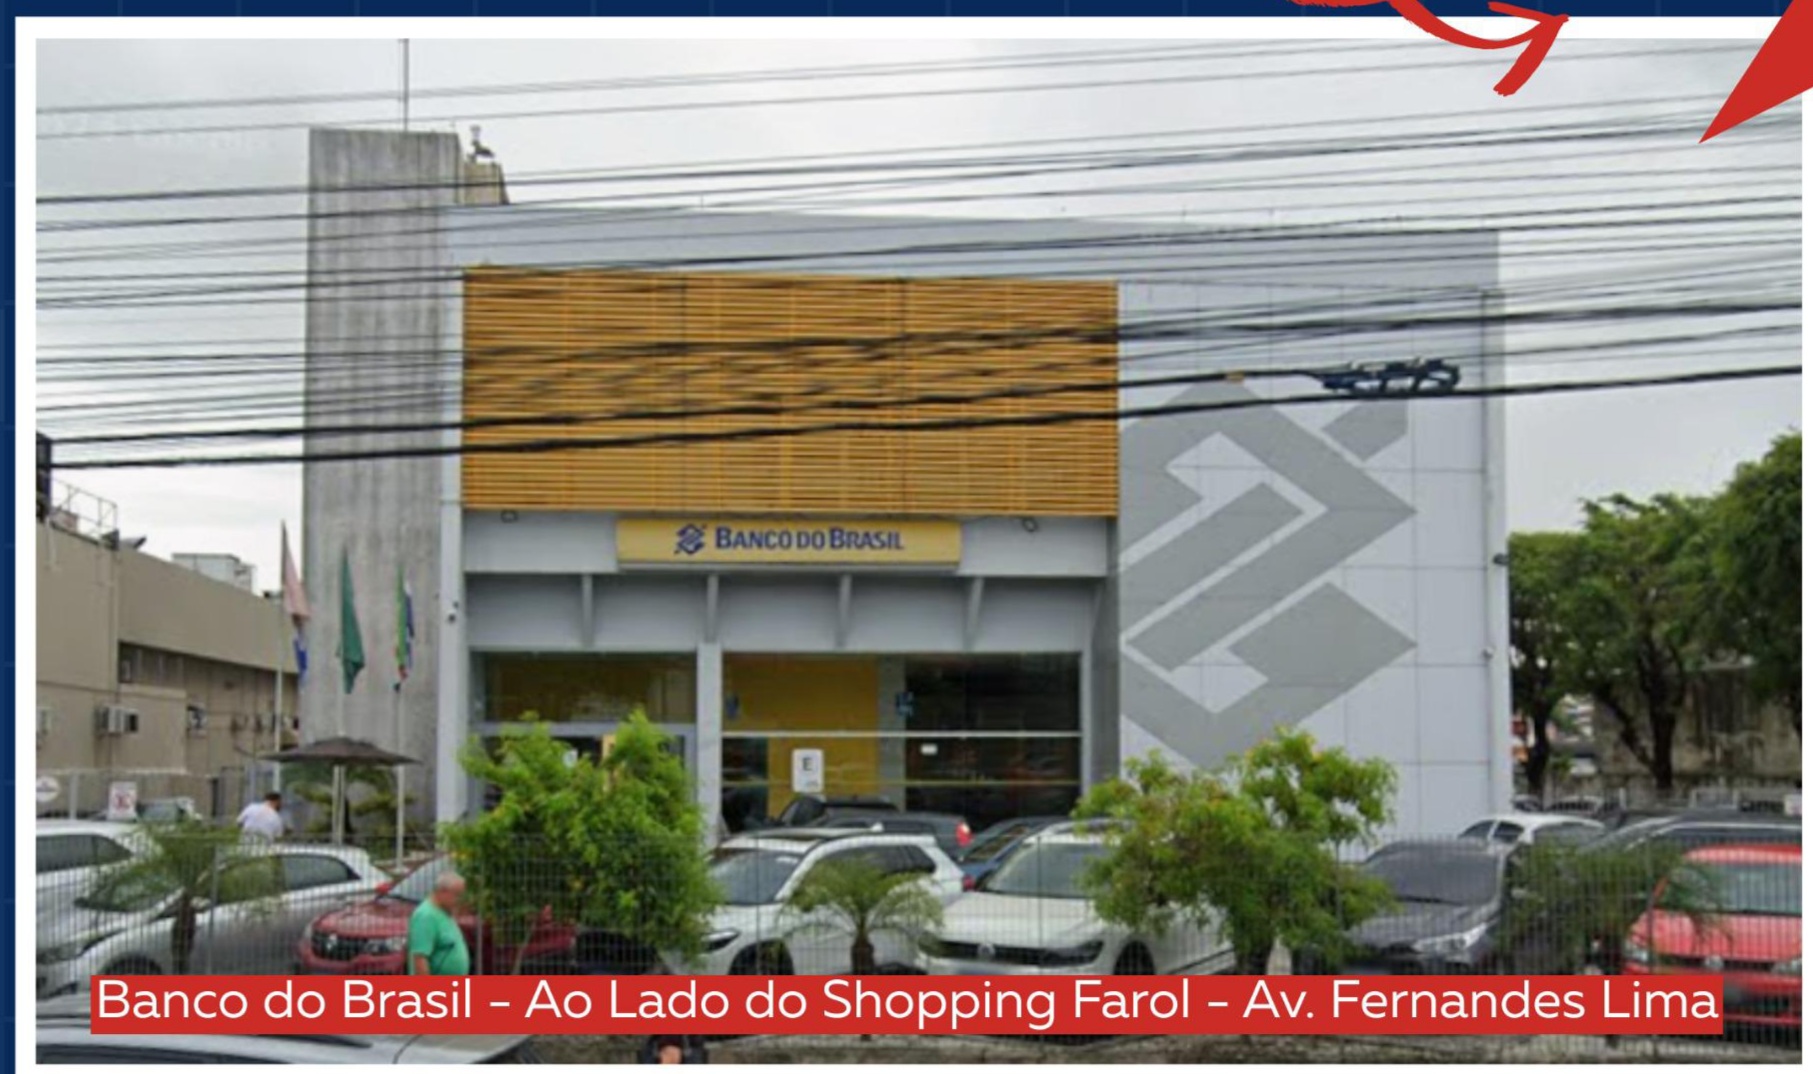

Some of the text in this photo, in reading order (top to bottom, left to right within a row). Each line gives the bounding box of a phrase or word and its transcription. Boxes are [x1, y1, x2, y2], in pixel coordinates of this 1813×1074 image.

[715, 526, 904, 551] BANCO DO BRASIL
